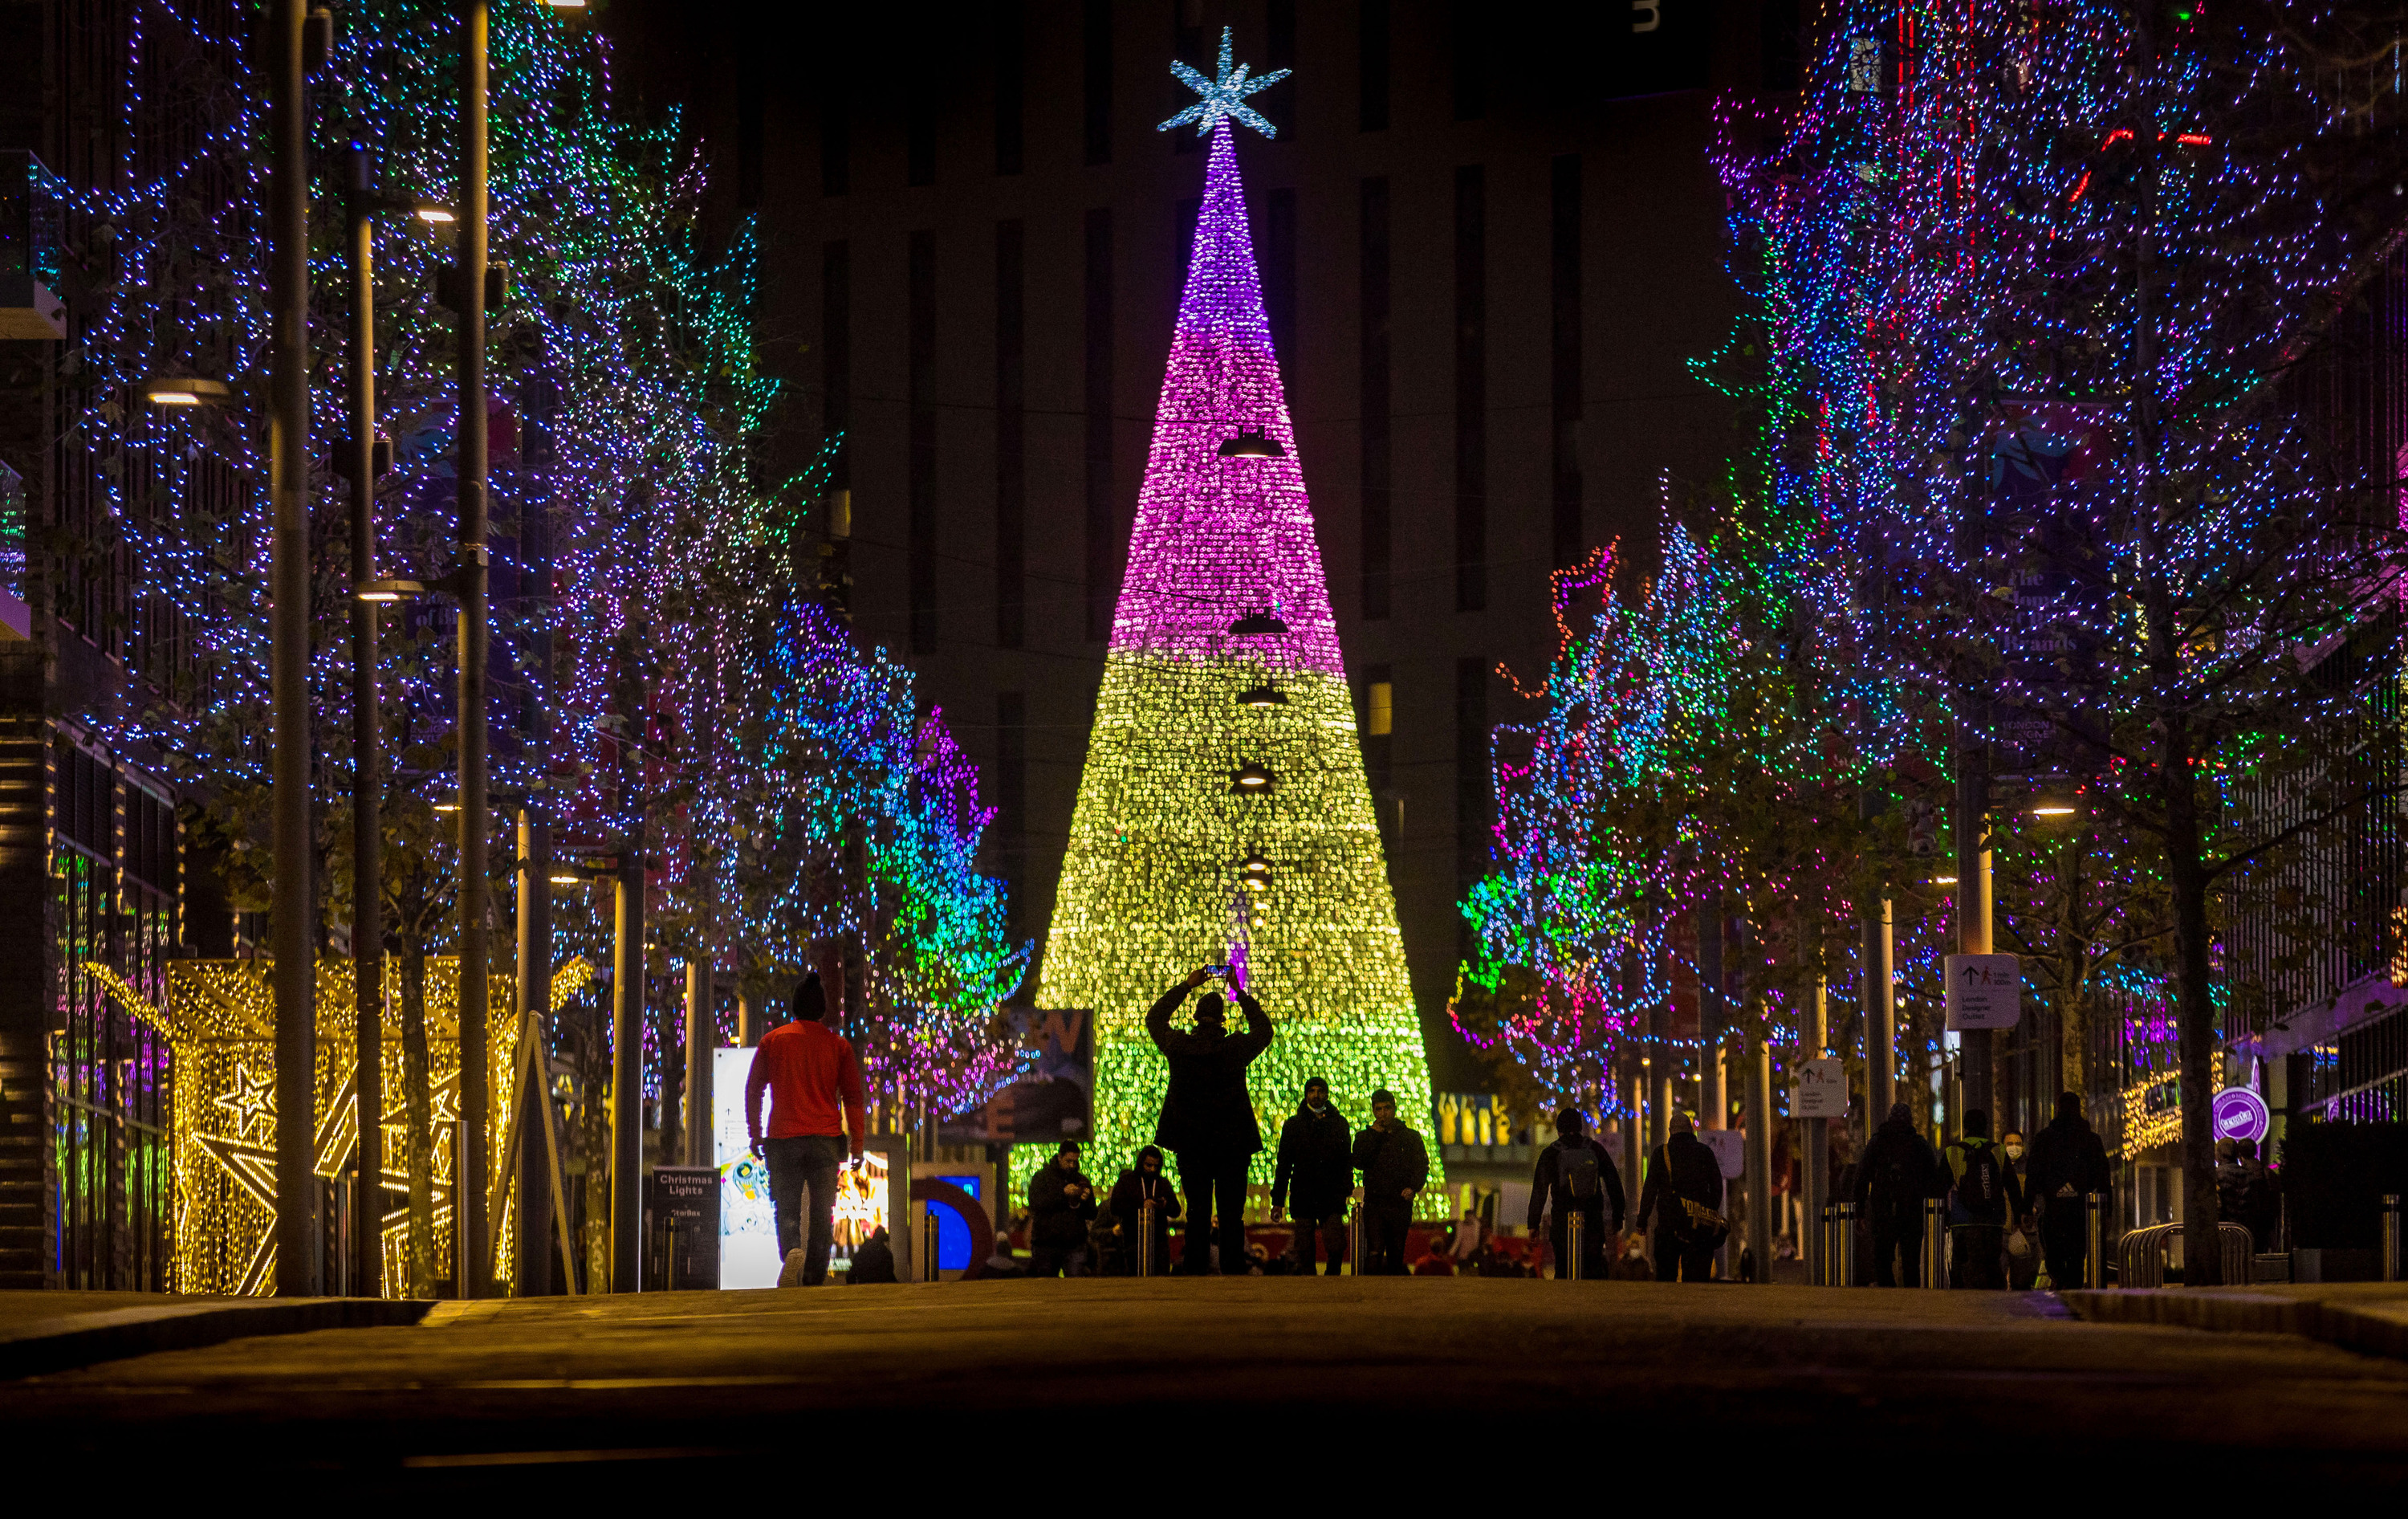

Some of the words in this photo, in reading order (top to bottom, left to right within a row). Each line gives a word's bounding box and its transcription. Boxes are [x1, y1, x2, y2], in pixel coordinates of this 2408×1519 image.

[2221, 1110, 2252, 1130] treatz
[660, 1174, 713, 1184] Christmas
[669, 1185, 703, 1196] Lights
